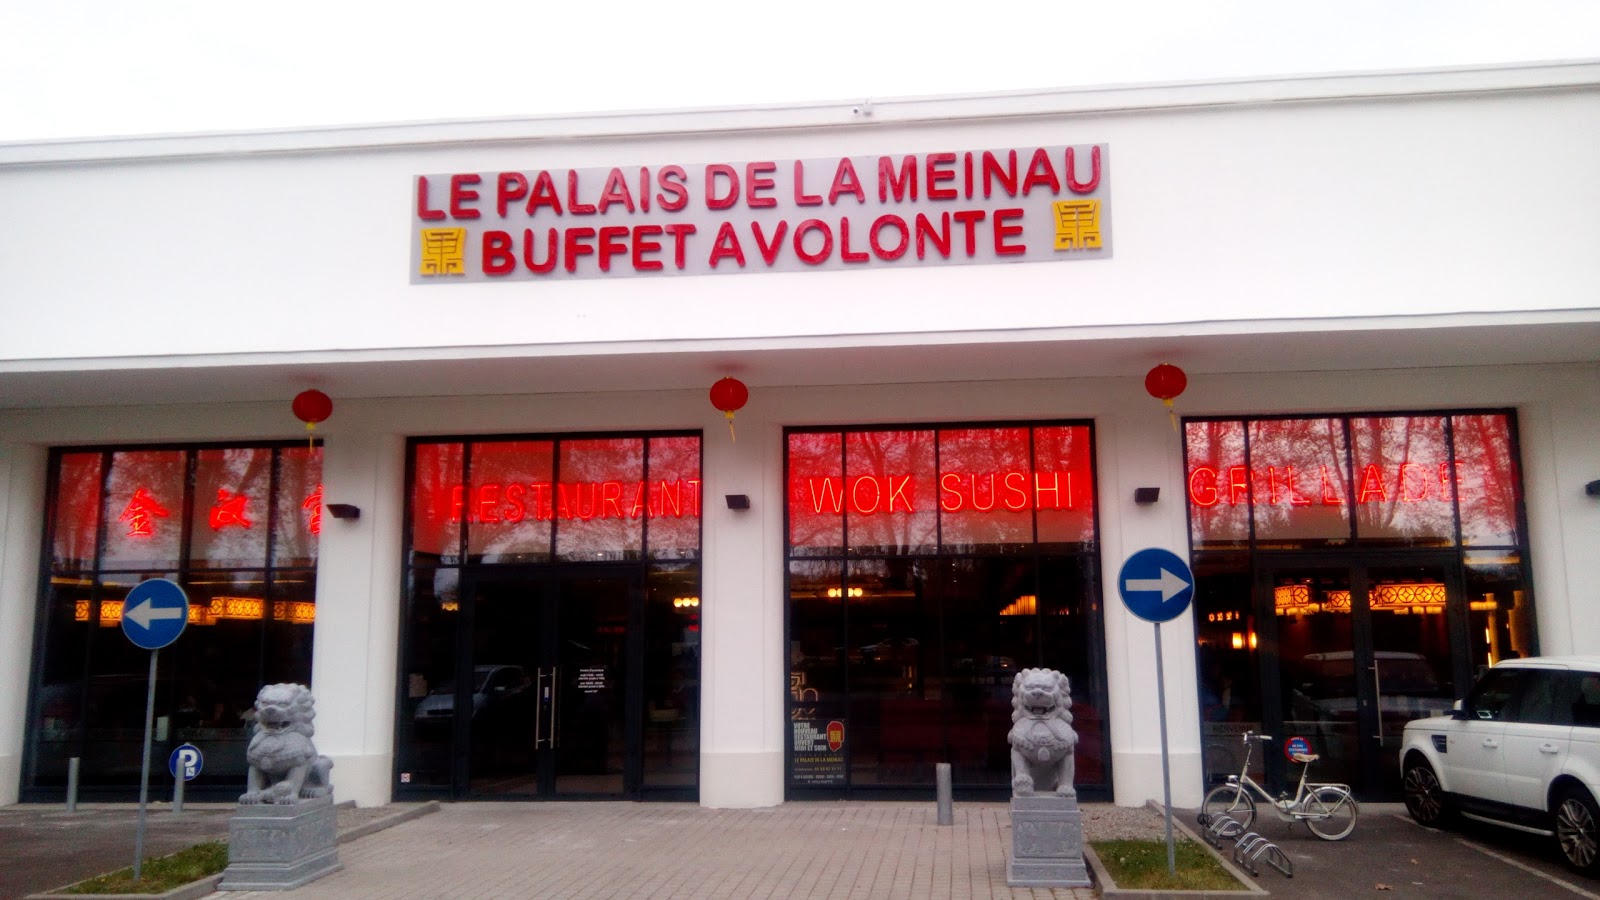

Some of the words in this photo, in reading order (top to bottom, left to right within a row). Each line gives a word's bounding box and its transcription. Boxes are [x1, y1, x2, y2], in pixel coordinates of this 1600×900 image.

[417, 174, 481, 221] LE
[496, 164, 690, 218] PALAIS
[705, 161, 777, 210] DE
[794, 157, 865, 206] LA
[878, 145, 1101, 204] MEINAU
[482, 223, 697, 276] BUFFET
[809, 475, 913, 514] WOK
[941, 472, 1072, 511] SUSHI
